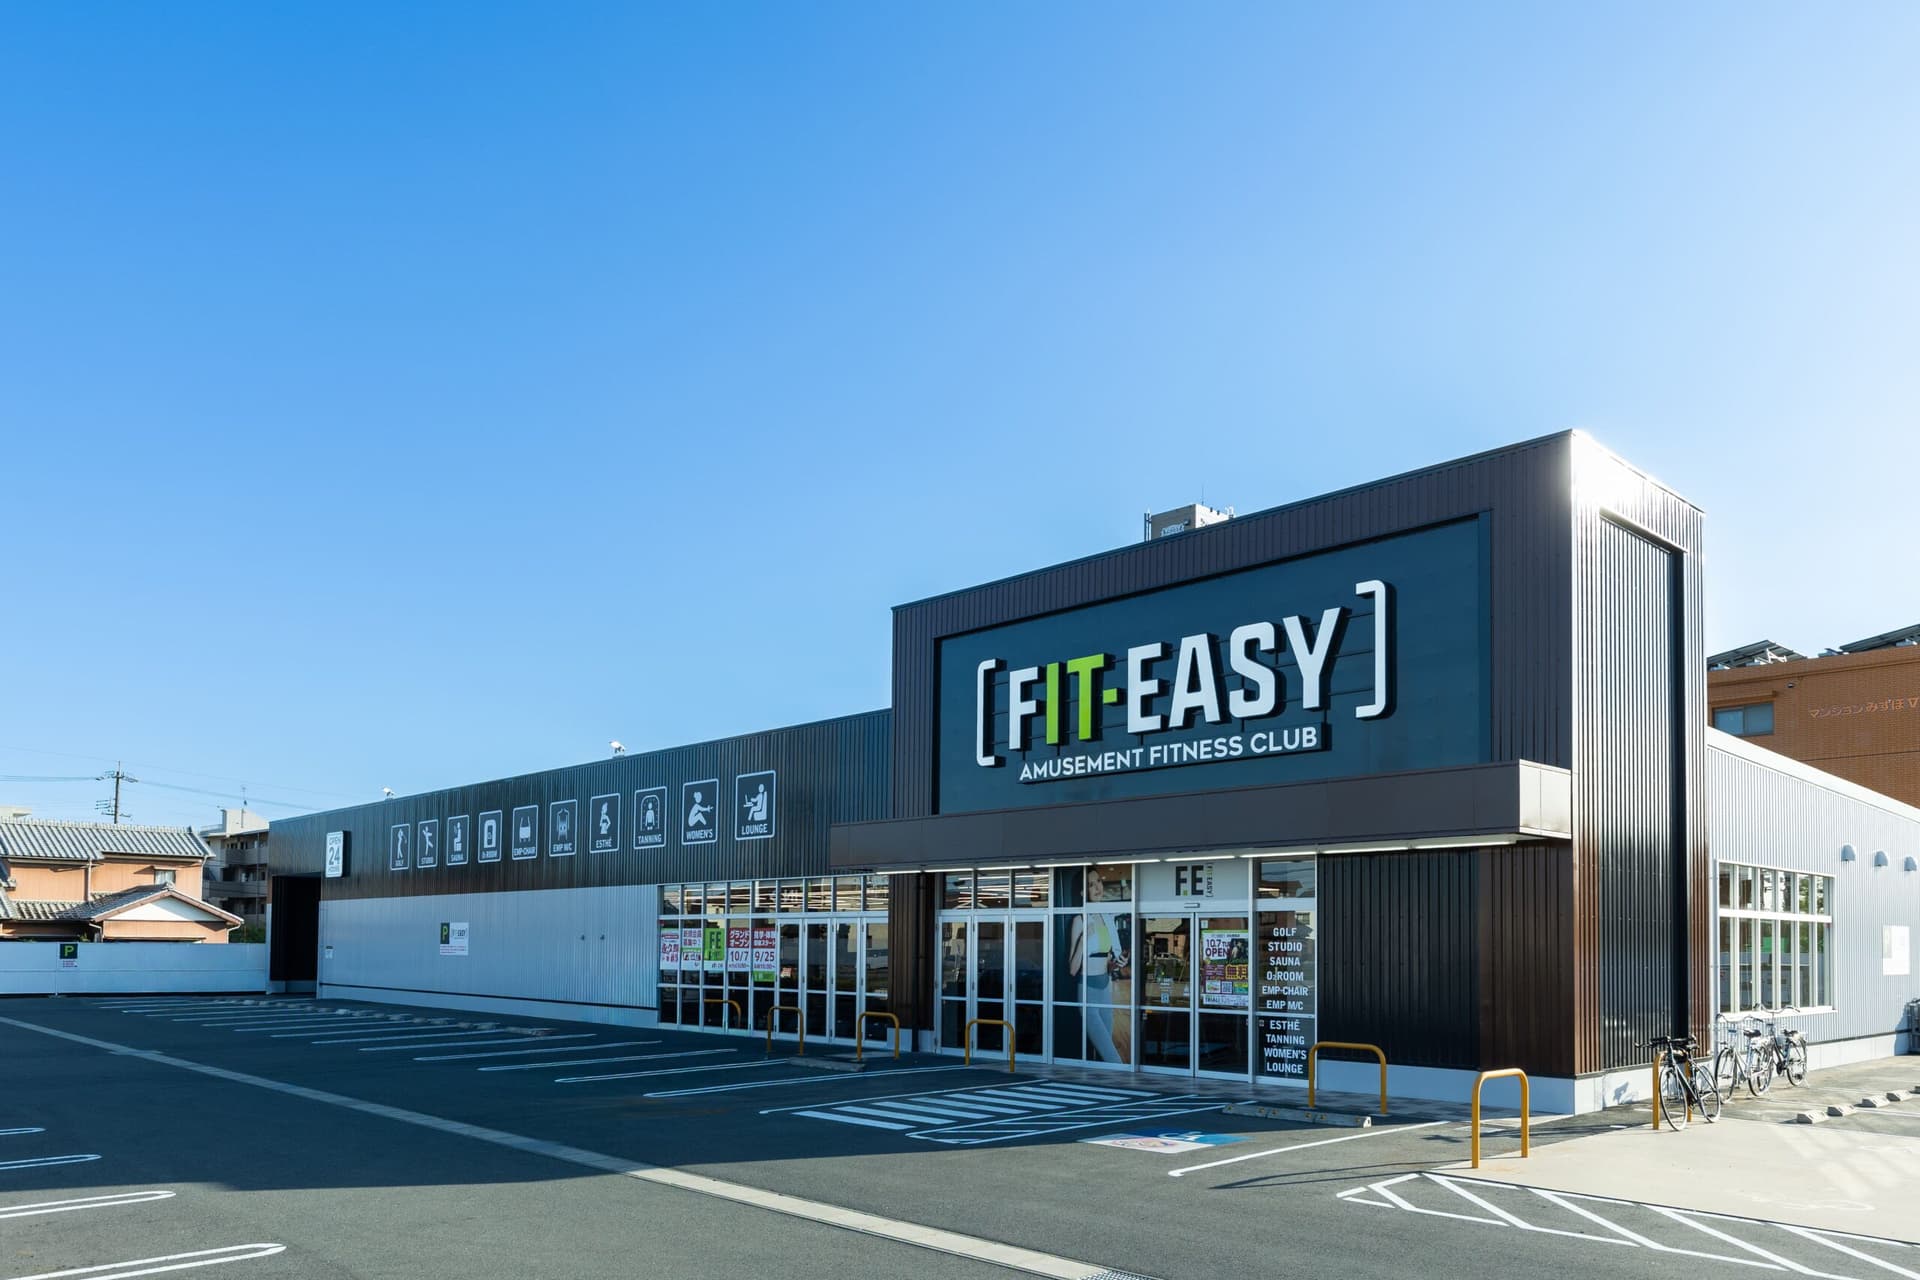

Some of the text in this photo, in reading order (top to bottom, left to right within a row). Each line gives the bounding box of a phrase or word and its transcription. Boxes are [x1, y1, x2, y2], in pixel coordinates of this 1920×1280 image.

[1019, 726, 1317, 781] AMUSEMENT FITNESS CLUB
[686, 828, 713, 840] WOMEN'S
[741, 823, 768, 835] LOUNGE
[638, 834, 662, 844] TANNING
[328, 846, 340, 866] 24
[442, 926, 449, 942] P
[1273, 927, 1297, 937] GOLF
[64, 945, 75, 957] P
[1205, 948, 1230, 957] OPEN
[1268, 941, 1303, 952] STUDIO
[730, 950, 749, 962] 10/7
[754, 951, 775, 962] 9/25
[1269, 957, 1301, 967] SAUNA
[1262, 985, 1309, 996] EMP-CHAIR
[1266, 1000, 1304, 1010] EMP M/C
[1265, 1033, 1305, 1045] TANNING
[1264, 1047, 1307, 1060] WOMEN'S
[1266, 1062, 1304, 1074] LOUNGE
